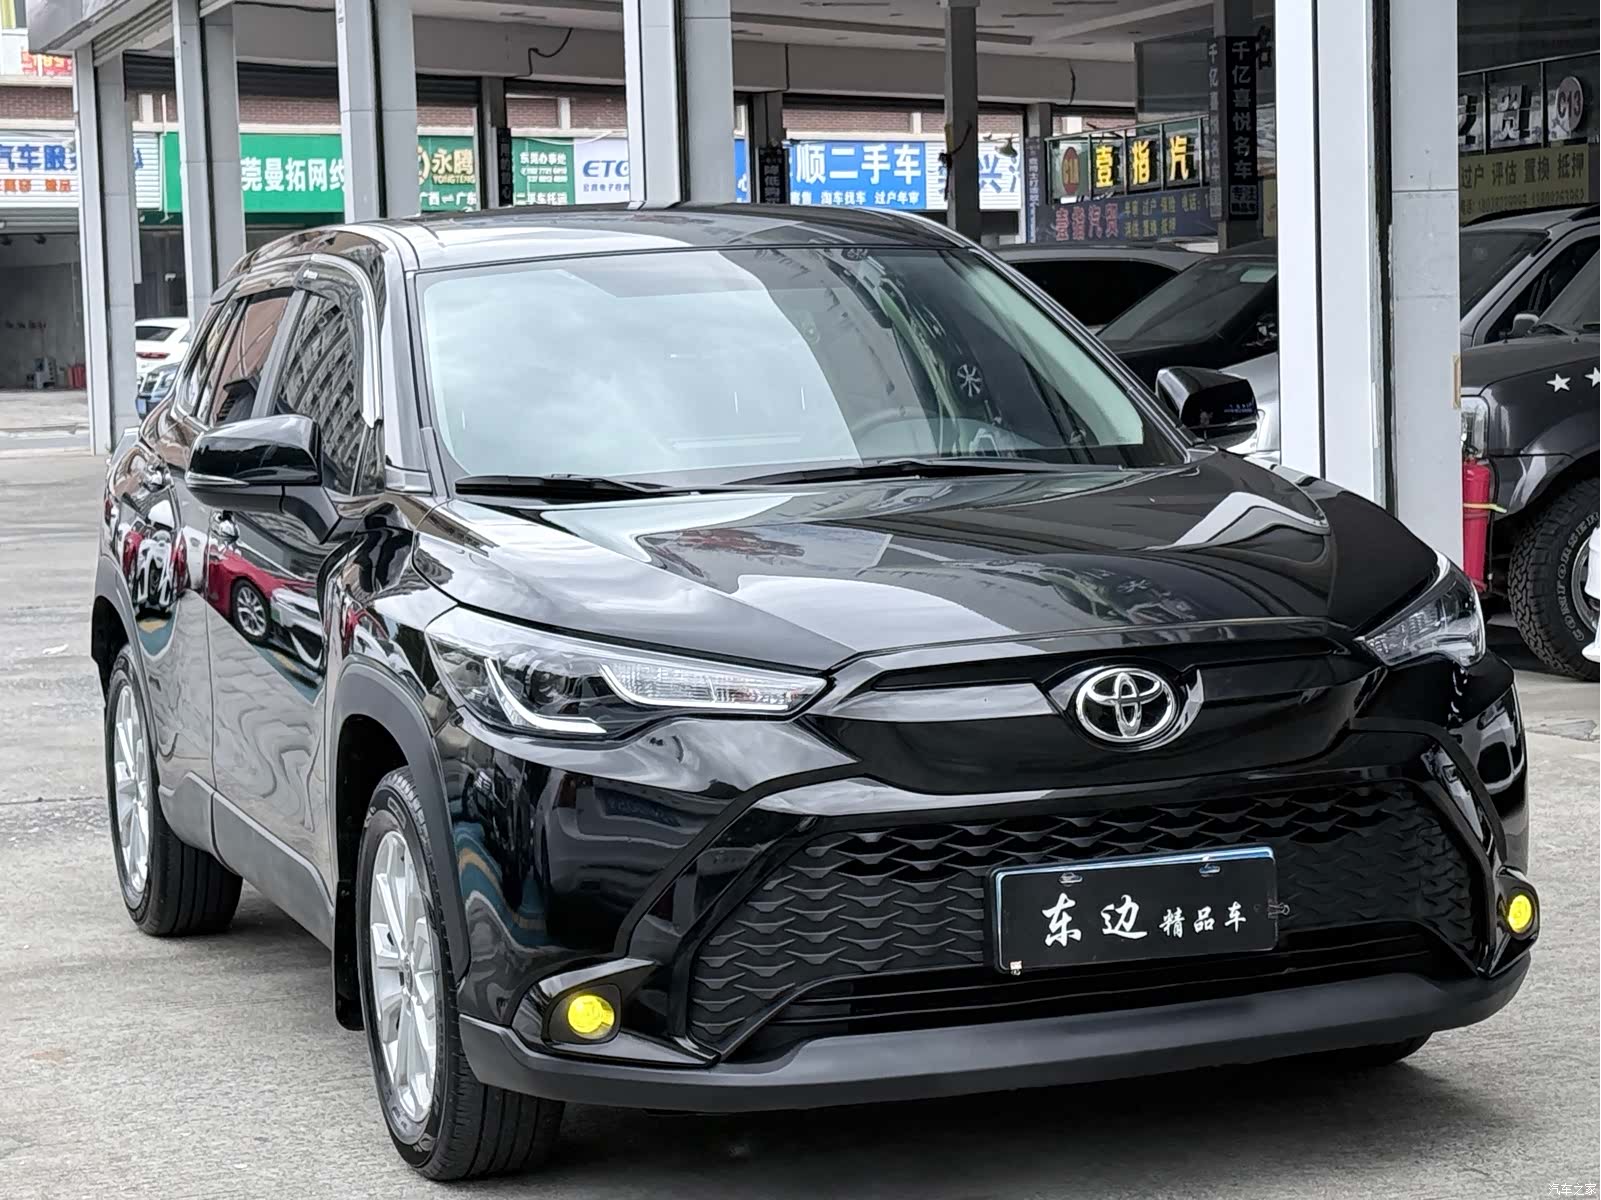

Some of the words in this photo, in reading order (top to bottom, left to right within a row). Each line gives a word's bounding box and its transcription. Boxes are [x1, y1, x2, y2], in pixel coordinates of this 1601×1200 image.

[1231, 41, 1253, 178] 千亿喜悦名车
[1558, 89, 1582, 119] C13
[0, 144, 77, 171] 汽车服
[431, 148, 473, 175] 永腾
[789, 144, 921, 185] 顺二手车
[1462, 164, 1484, 189] 过户
[1492, 160, 1517, 187] 评估
[1524, 156, 1550, 184] 置换
[1557, 152, 1585, 180] 抵押
[1041, 892, 1148, 947] 东边
[1158, 901, 1248, 939] 精品车
